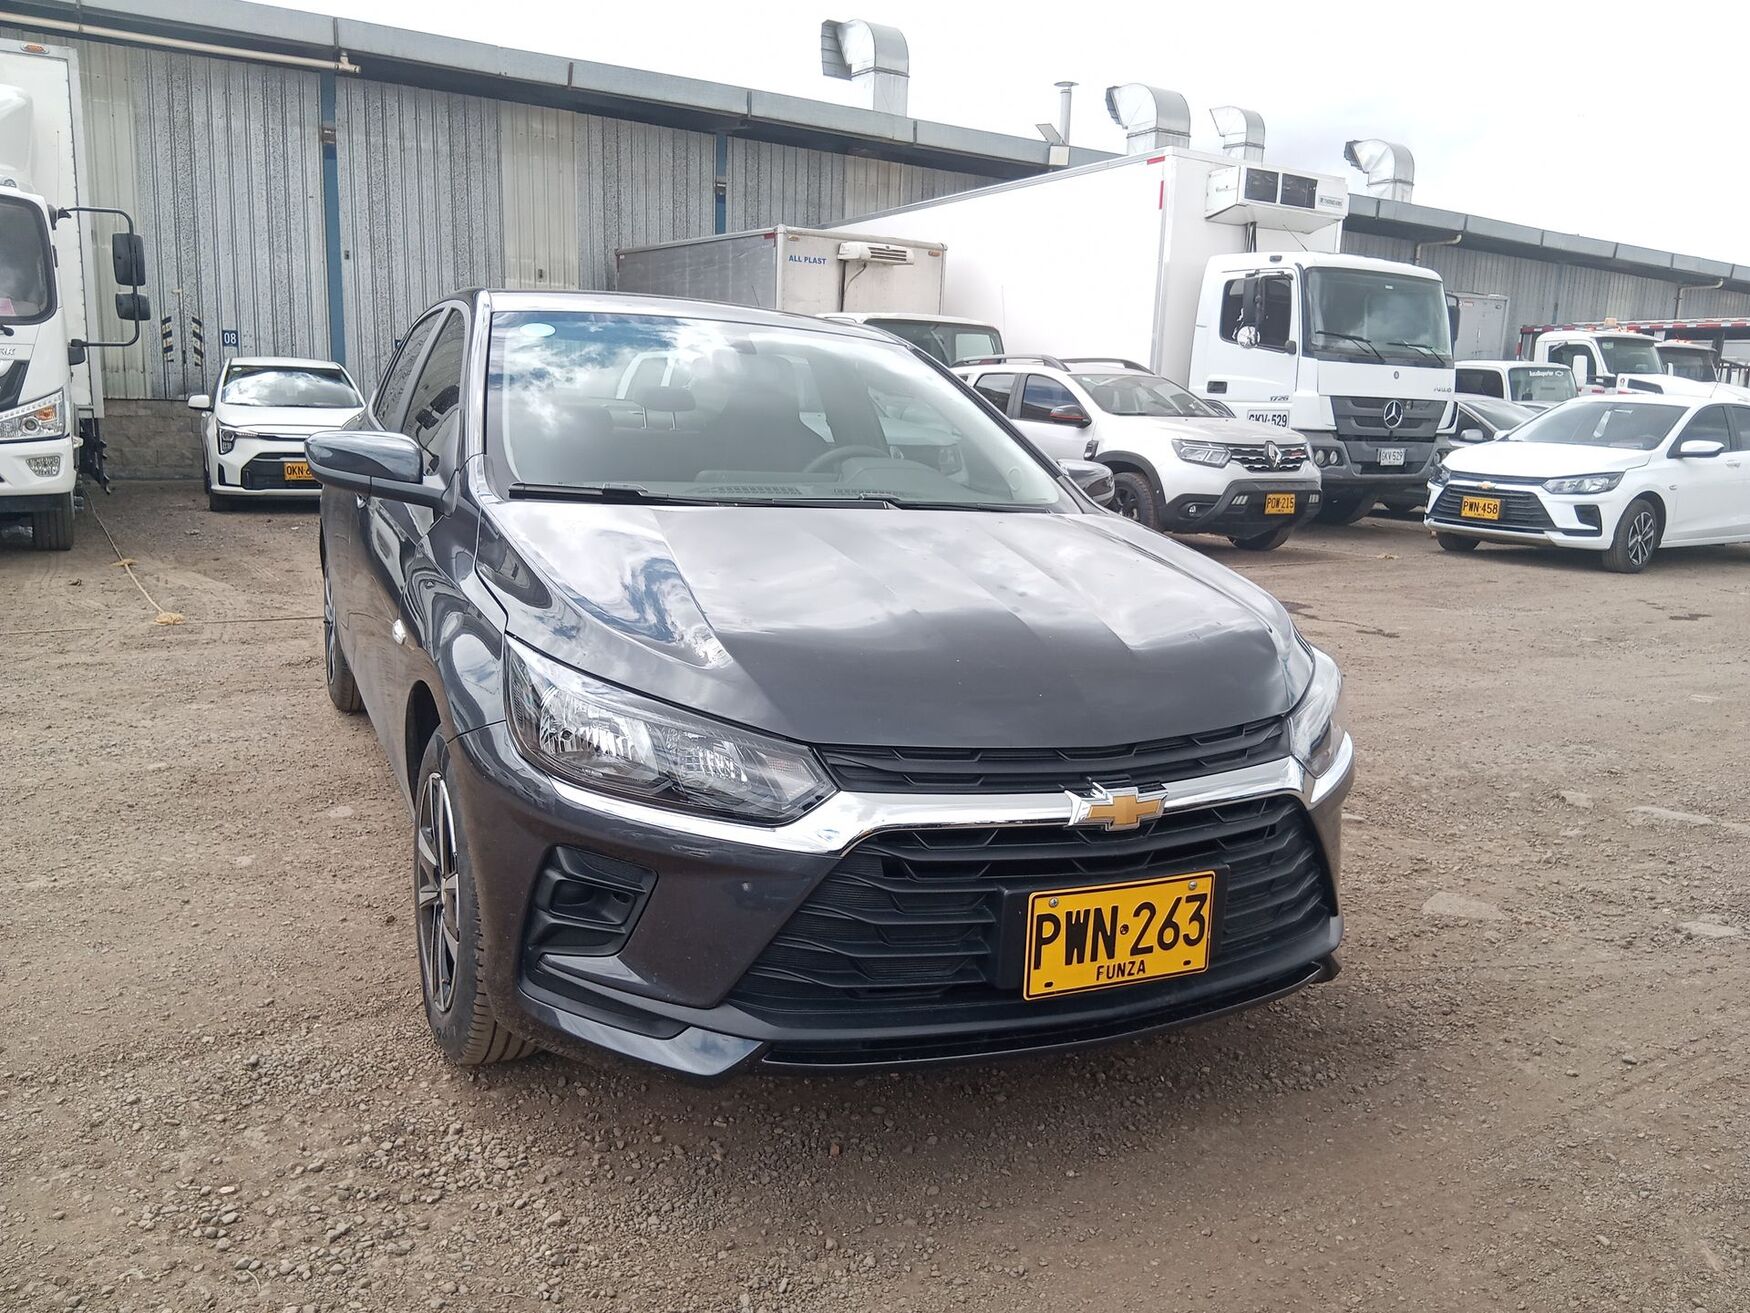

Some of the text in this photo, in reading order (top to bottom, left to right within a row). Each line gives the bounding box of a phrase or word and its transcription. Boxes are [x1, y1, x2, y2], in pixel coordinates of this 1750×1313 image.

[803, 256, 827, 265] PLAST
[223, 332, 237, 344] 08
[1095, 959, 1147, 981] FUNZA
